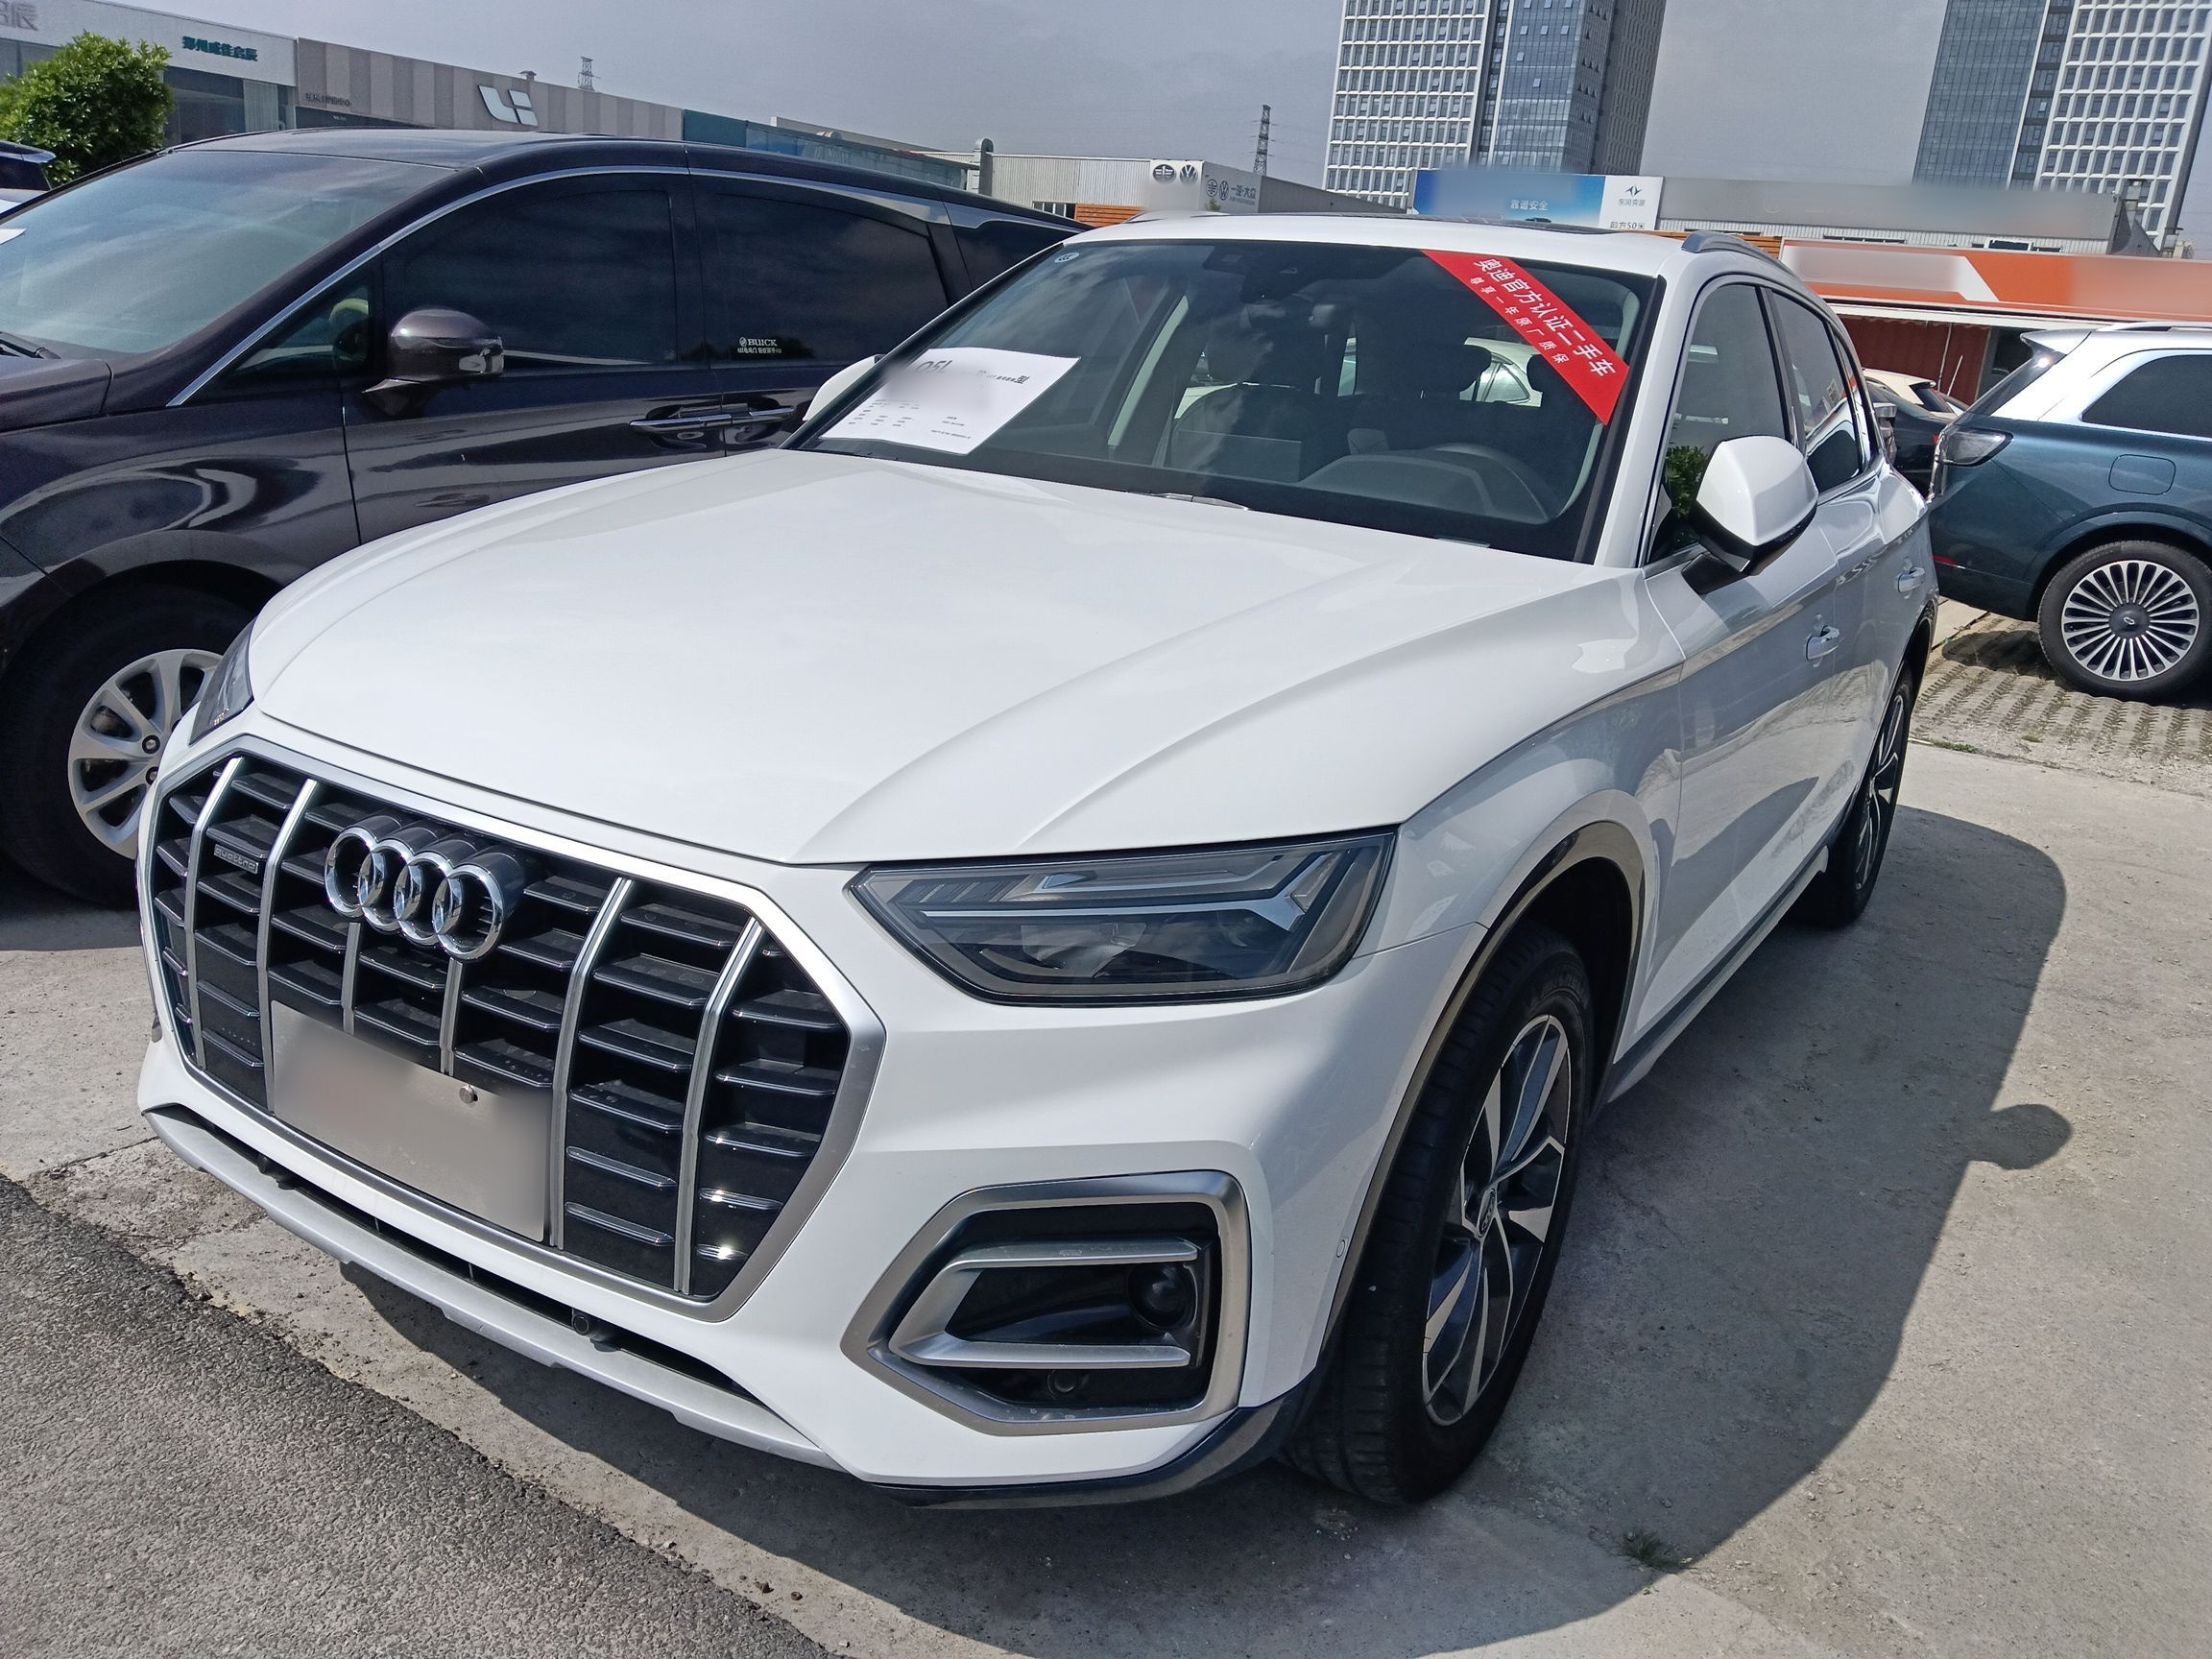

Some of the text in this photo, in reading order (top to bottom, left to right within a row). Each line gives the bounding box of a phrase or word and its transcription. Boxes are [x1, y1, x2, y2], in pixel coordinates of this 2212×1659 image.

[747, 338, 778, 347] BUICK
[1469, 276, 1571, 365] 尊享一年原厂质保
[1473, 257, 1617, 377] 奥迪官方认证二手车
[215, 847, 256, 870] quattro
